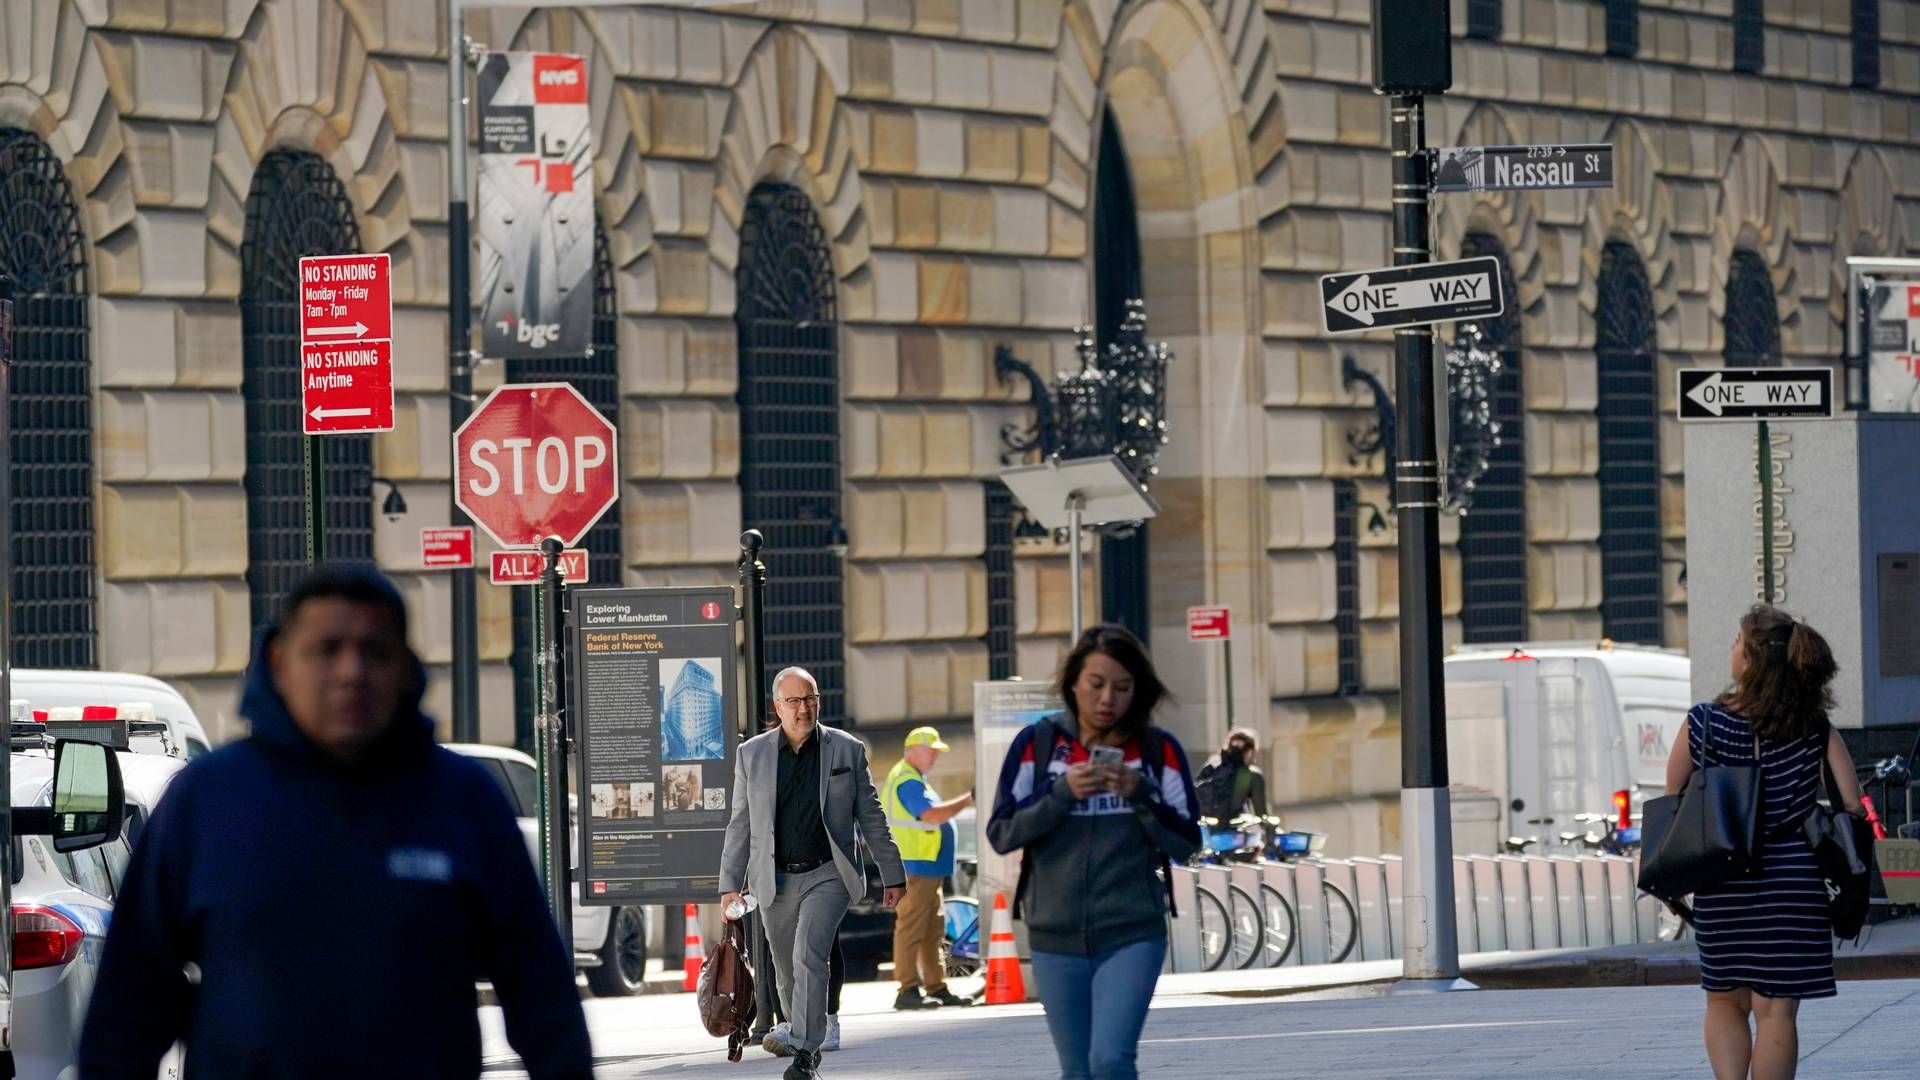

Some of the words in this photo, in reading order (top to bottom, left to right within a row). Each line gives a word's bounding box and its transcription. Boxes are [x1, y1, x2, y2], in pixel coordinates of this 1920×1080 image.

[1527, 147, 1552, 158] 27-39
[1494, 156, 1575, 187] Nassau
[1584, 154, 1600, 173] St
[305, 267, 320, 283] NO
[323, 264, 376, 282] STANDING
[306, 287, 336, 301] Monday
[344, 286, 368, 301] Friday
[1343, 287, 1399, 313] ONE
[1429, 277, 1482, 303] WAY
[306, 305, 323, 317] 7am
[330, 304, 347, 319] 7pm
[517, 318, 560, 348] bgc
[307, 353, 322, 369] NO
[325, 350, 378, 368] STANDING
[308, 373, 353, 392] Anytime
[1703, 385, 1744, 403] ONE
[1767, 385, 1811, 403] WAY
[469, 435, 606, 496] STOP
[500, 557, 534, 576] ALL
[544, 557, 579, 575] AY
[587, 605, 631, 614] Exploring
[587, 614, 616, 624] Lower
[618, 613, 668, 623] Manhattan
[587, 633, 619, 642] Federal
[621, 632, 656, 641] Reserve
[587, 643, 609, 651] Bank
[611, 642, 620, 650] of
[622, 642, 642, 650] New
[644, 641, 664, 650] York
